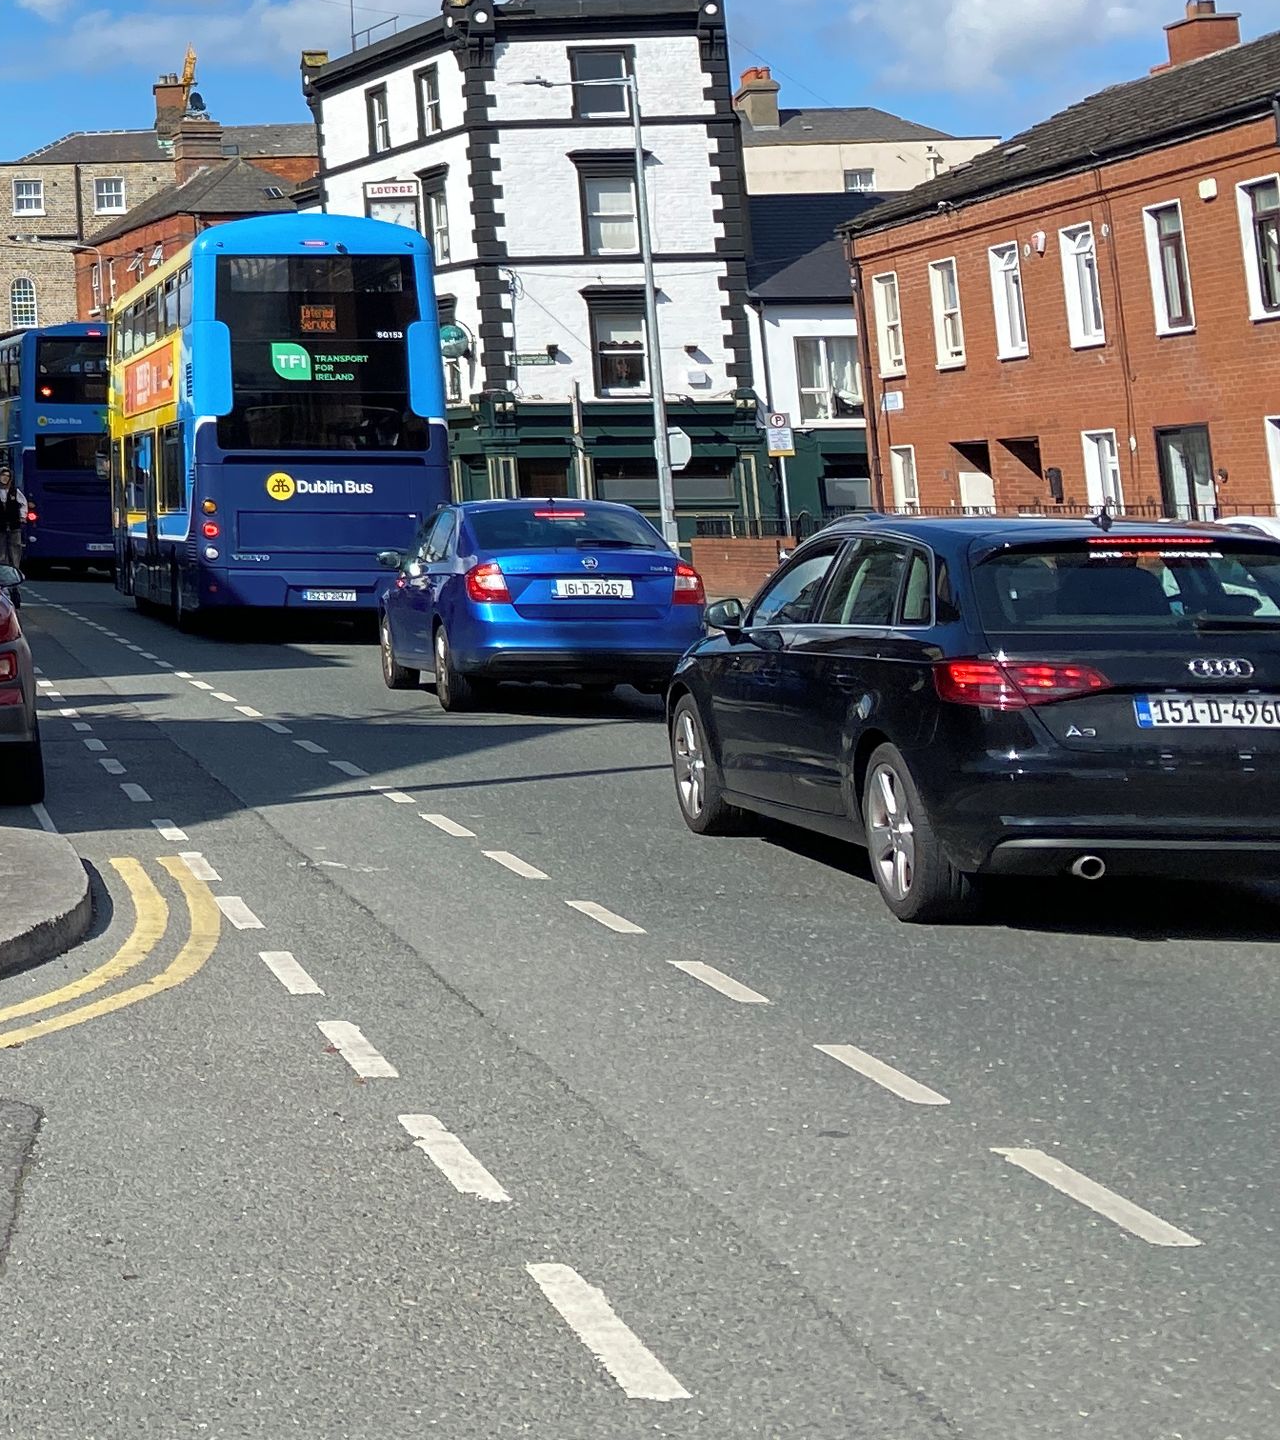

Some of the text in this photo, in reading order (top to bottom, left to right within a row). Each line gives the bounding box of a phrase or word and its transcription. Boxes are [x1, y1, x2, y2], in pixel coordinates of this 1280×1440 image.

[370, 185, 414, 195] LOUNGE
[276, 354, 307, 369] TFI
[314, 355, 369, 363] TRANSPORT
[314, 364, 334, 372] FOR
[314, 372, 355, 381] IRELAND
[296, 480, 374, 494] Dublin Bus
[565, 583, 624, 596] 161-D-21267
[1065, 725, 1097, 738] A3
